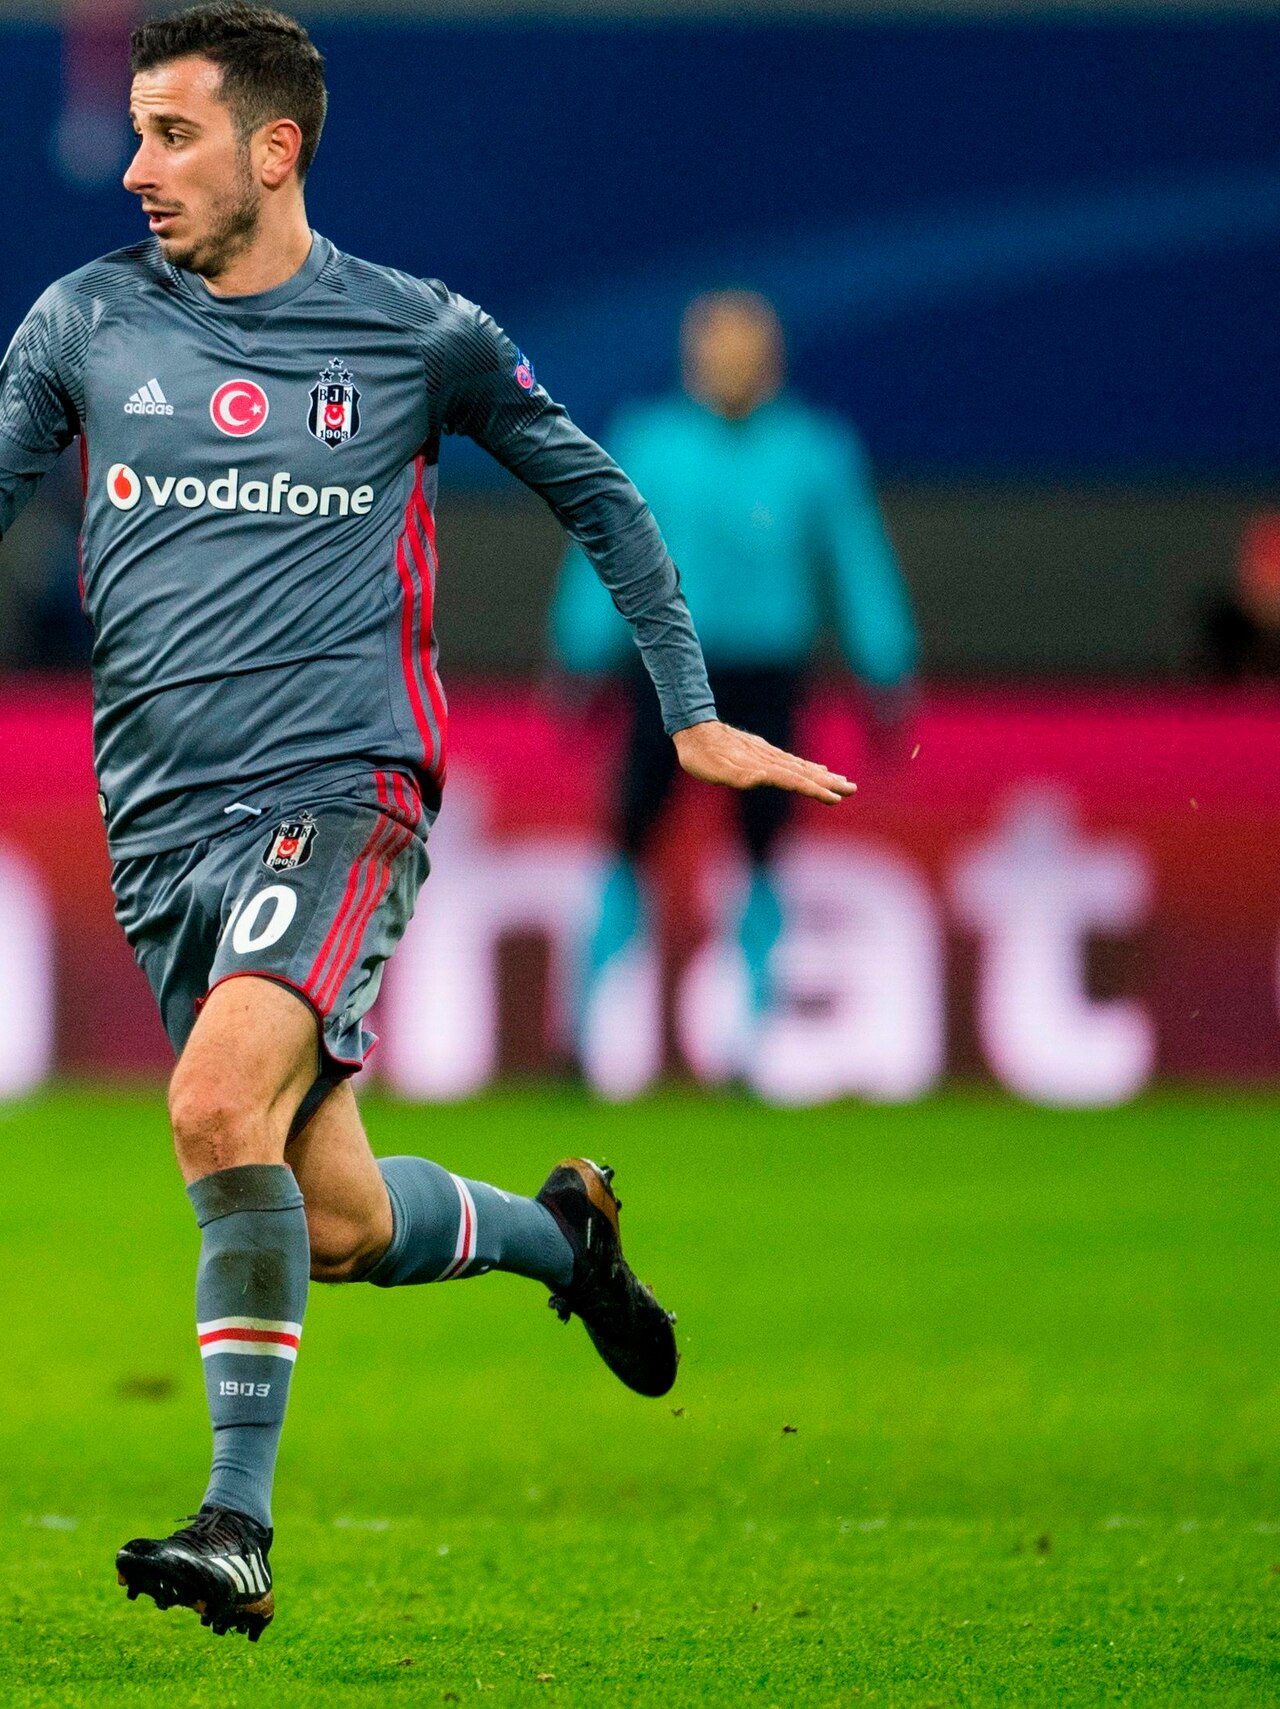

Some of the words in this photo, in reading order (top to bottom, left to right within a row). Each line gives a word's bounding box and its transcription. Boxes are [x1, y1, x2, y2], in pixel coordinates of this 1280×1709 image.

[319, 388, 352, 403] BJK
[123, 400, 174, 416] adidas
[320, 430, 349, 439] 1903
[145, 468, 375, 517] vodafone
[362, 772, 1160, 1108] hat
[219, 1380, 271, 1398] 1903
